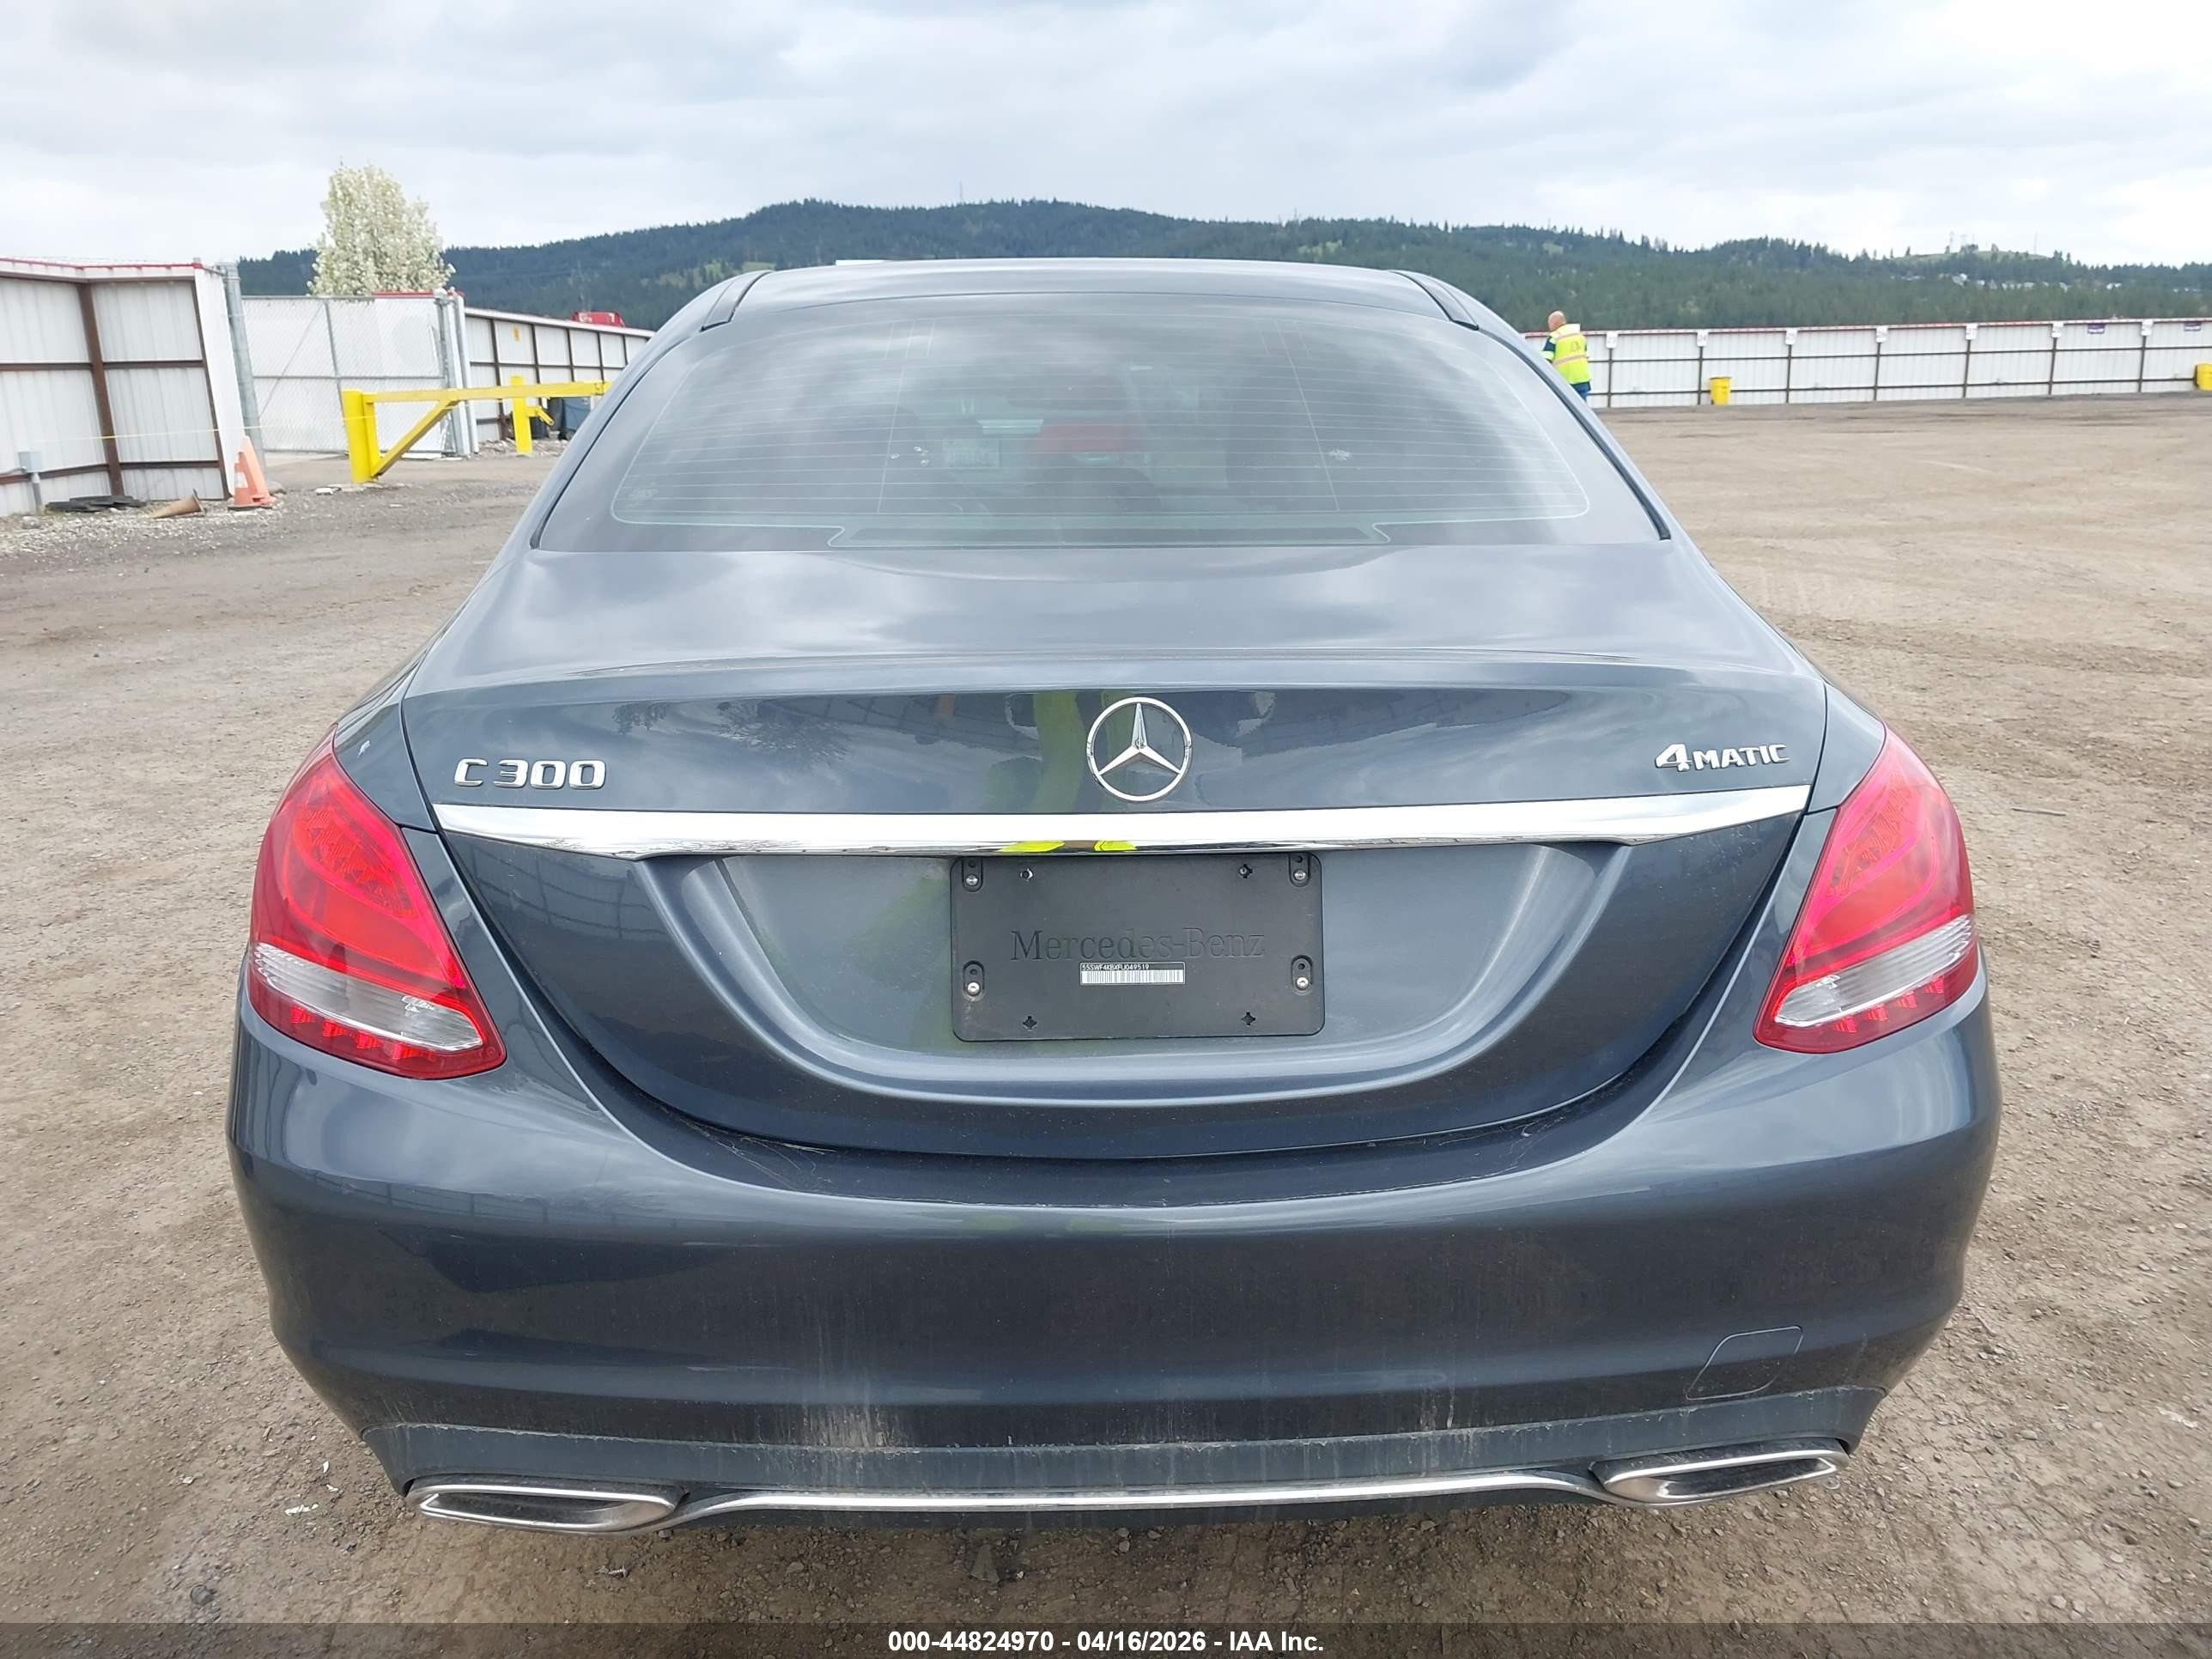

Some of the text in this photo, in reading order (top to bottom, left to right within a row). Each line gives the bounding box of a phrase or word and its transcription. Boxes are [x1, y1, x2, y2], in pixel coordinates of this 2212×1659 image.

[1655, 743, 1790, 772] 4MATIC
[453, 758, 607, 790] C 300
[1010, 927, 1266, 961] Mercedes-Benz
